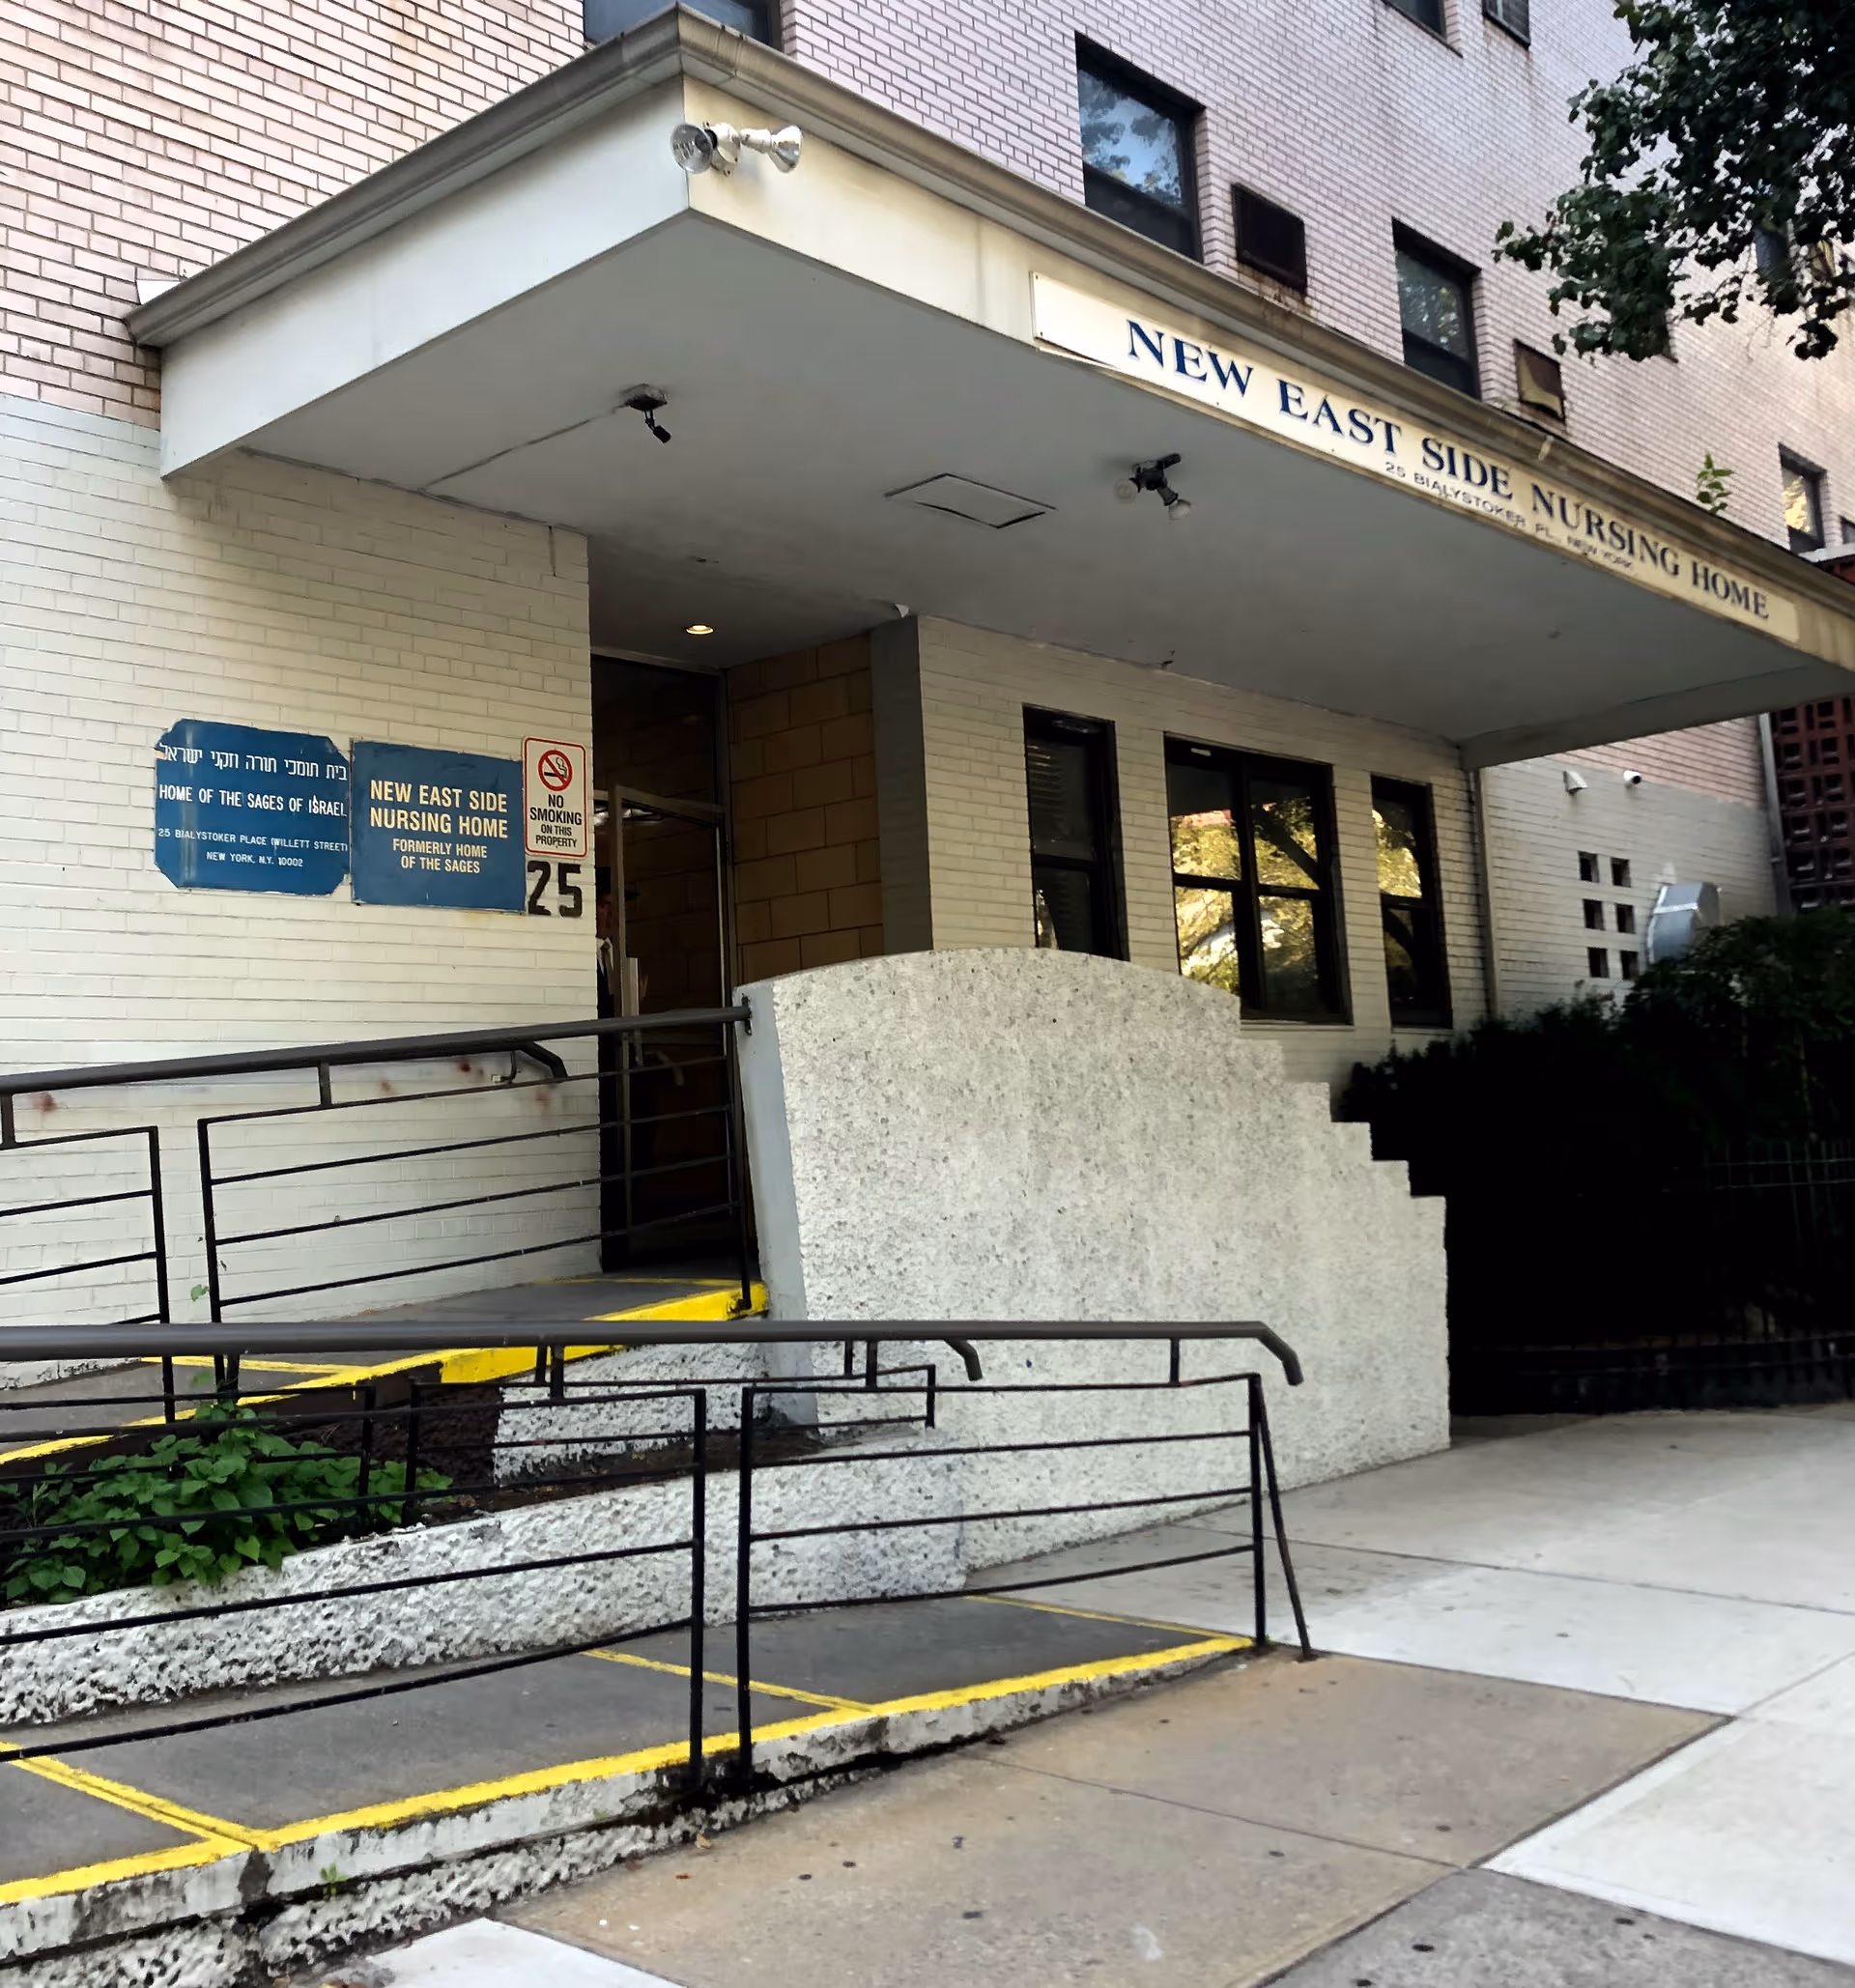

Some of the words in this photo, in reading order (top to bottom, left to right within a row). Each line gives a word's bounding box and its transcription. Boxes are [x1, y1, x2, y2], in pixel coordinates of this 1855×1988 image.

[1126, 320, 1253, 397] NEW
[1277, 378, 1402, 455] EAST
[1421, 436, 1513, 500] SIDE
[1531, 482, 1680, 578] NURSING
[1692, 560, 1770, 620] HOME
[1384, 461, 1407, 479] 25
[1413, 471, 1527, 527] BIALYSTOKER
[158, 742, 203, 764] ישראל
[245, 754, 277, 773] תורה
[326, 764, 348, 781] בית
[158, 783, 193, 802] HOME
[198, 787, 214, 804] OF
[218, 789, 243, 808] THE
[246, 792, 284, 811] SAGES
[289, 797, 303, 812] OF
[308, 798, 348, 817] ISRAEL
[370, 779, 413, 803] NEW
[418, 784, 463, 809] EAST
[469, 790, 508, 813] SIDE
[548, 793, 564, 809] NO
[370, 807, 452, 835] NURSING
[458, 815, 509, 838] HOME
[529, 806, 584, 827] SMOKING
[157, 827, 171, 838] 25
[175, 829, 237, 843] BIALYSTOKER
[240, 835, 267, 846] PLACE
[540, 824, 554, 835] ON
[555, 826, 573, 838] THIS
[392, 838, 452, 856] FORMERLY
[455, 843, 488, 859] HOME
[535, 835, 578, 849] PROPERTY
[206, 851, 226, 862] NEW
[258, 855, 274, 866] N.Y.
[277, 856, 303, 867] 10002
[401, 856, 416, 869] OF
[419, 857, 442, 872] THE
[444, 859, 481, 874] SAGES
[527, 860, 583, 918] 25
